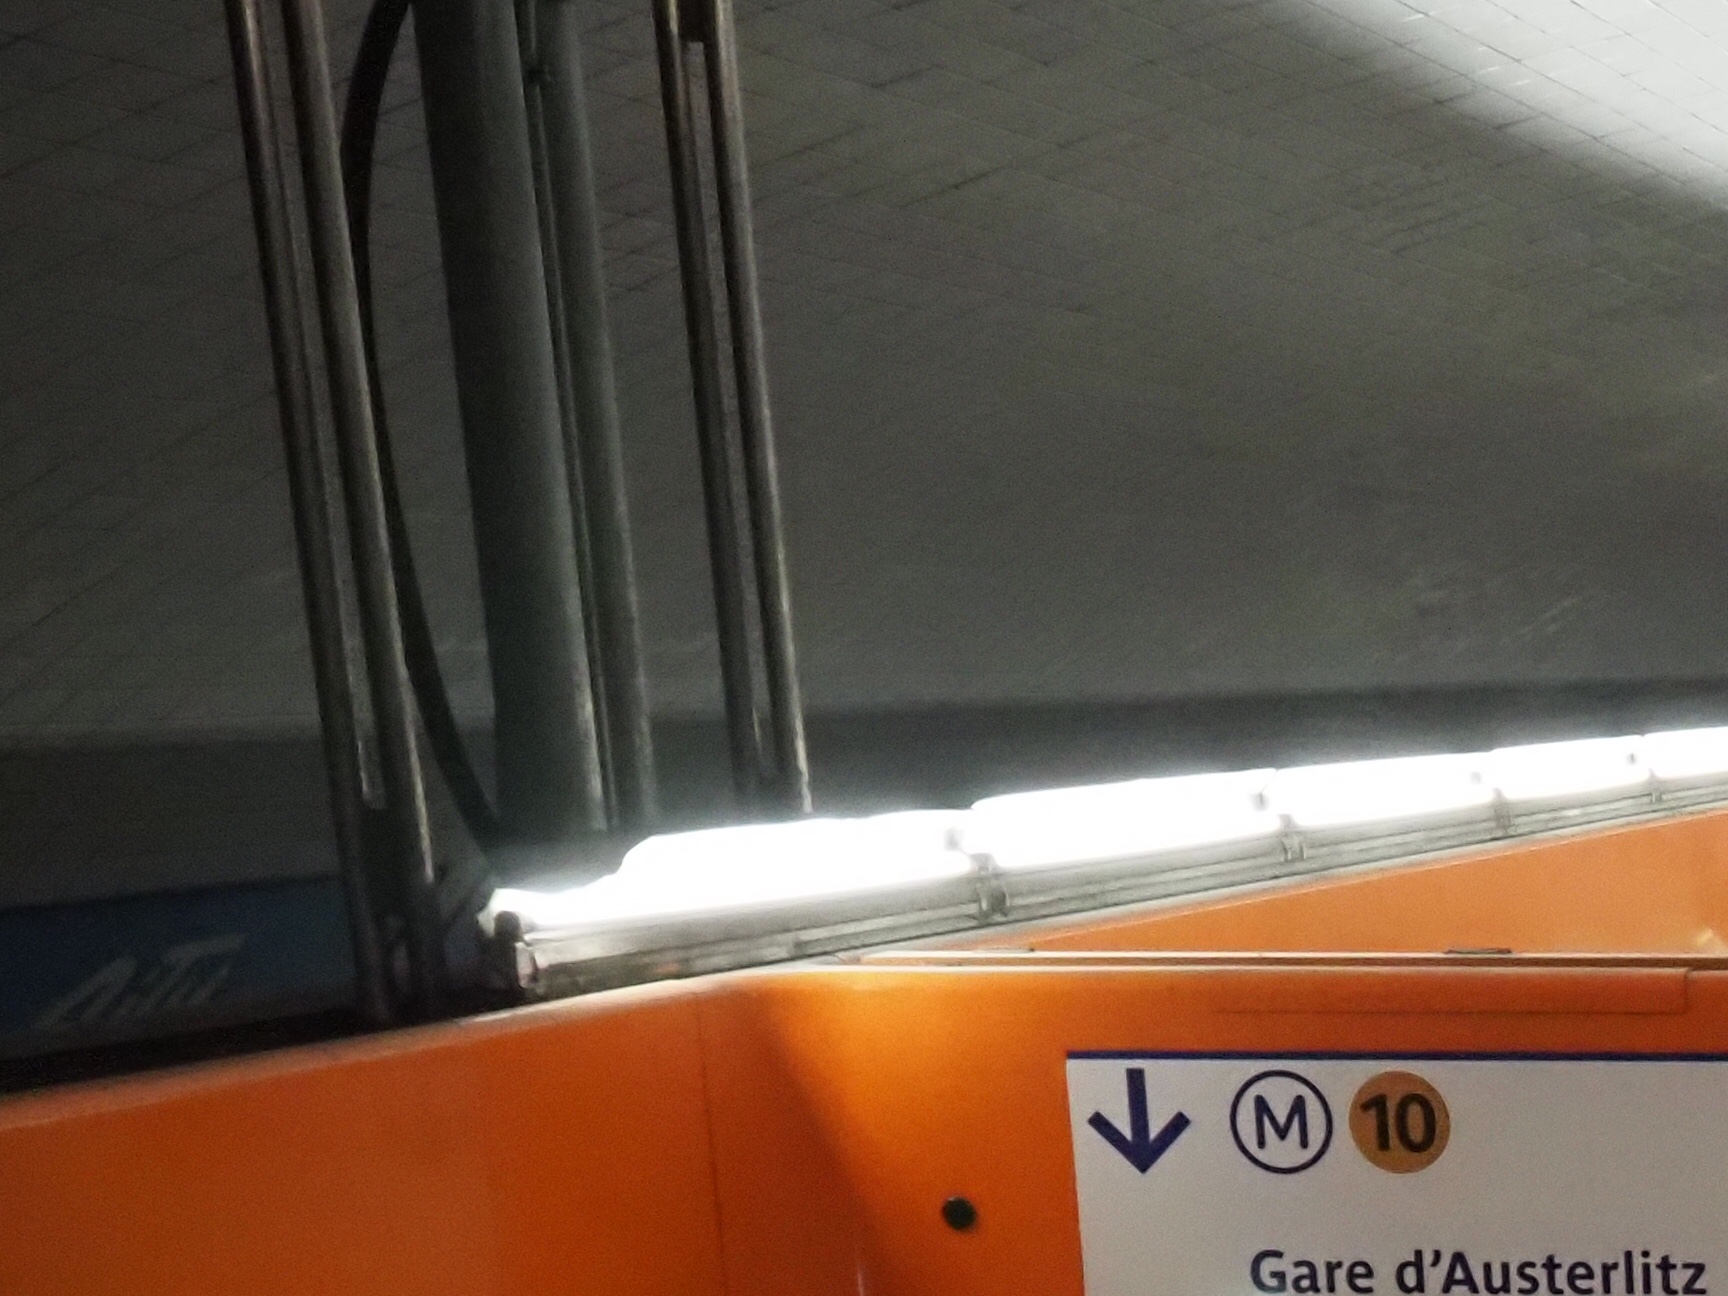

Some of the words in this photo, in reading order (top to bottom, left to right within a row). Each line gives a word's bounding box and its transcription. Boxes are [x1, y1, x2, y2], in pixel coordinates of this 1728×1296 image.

[1359, 1092, 1438, 1154] 10
[1249, 1249, 1375, 1296] Gare
[1396, 1249, 1708, 1296] d'Austerlitz
